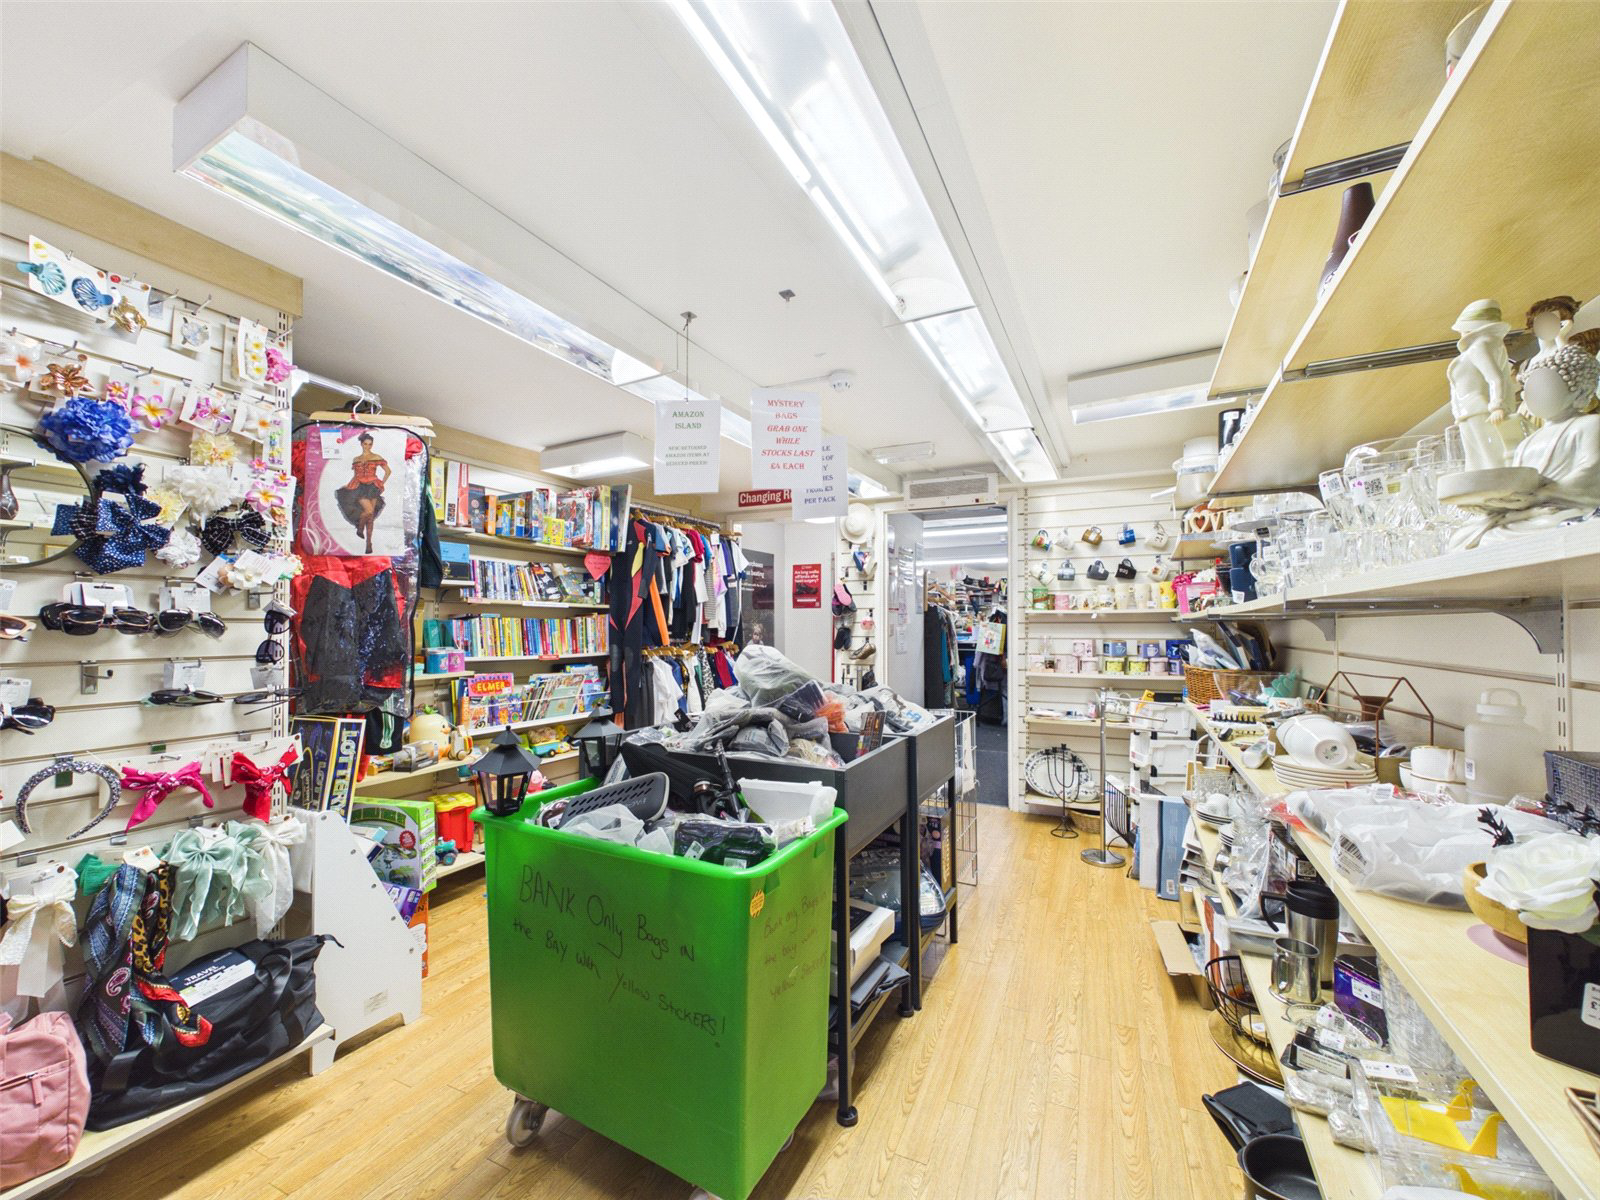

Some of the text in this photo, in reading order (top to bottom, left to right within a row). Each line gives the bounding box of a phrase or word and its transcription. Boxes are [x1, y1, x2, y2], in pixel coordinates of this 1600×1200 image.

[767, 399, 805, 408] MYSTERY
[672, 410, 705, 418] AMAZON
[775, 412, 798, 420] BAGS
[674, 422, 702, 430] ISLAND
[767, 424, 808, 433] GRAB ONE
[775, 437, 801, 445] WHILE
[760, 449, 815, 457] STOCKS LAST
[782, 462, 805, 470] EACH
[740, 490, 782, 504] Changing
[476, 681, 506, 693] ELMER
[519, 863, 576, 918] BANK
[586, 894, 624, 961] Only
[636, 913, 670, 961] Bags
[512, 917, 534, 941] the
[184, 965, 219, 982] TRAVEL
